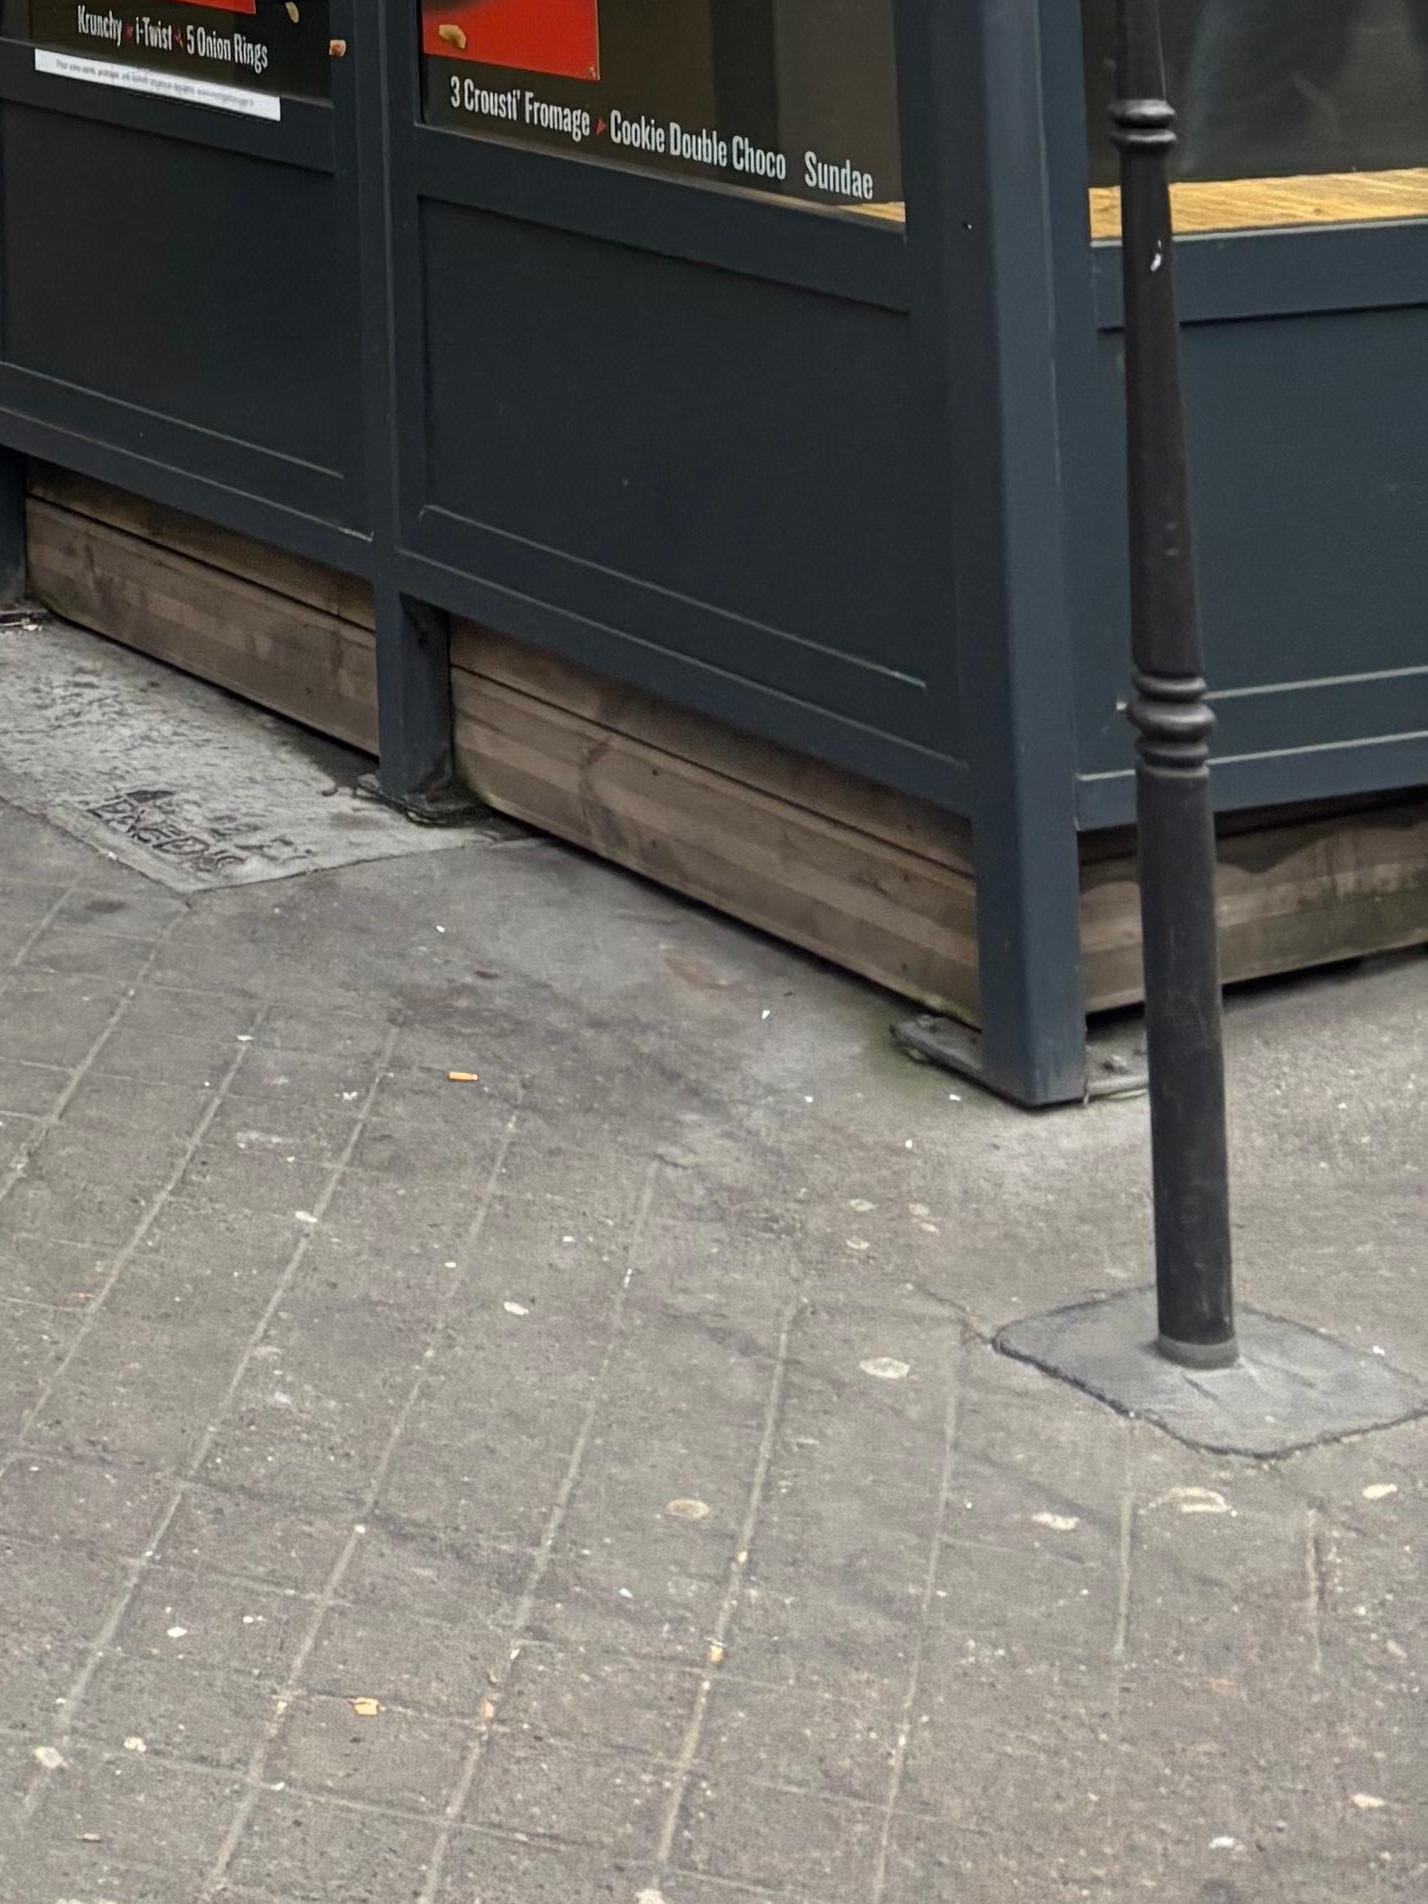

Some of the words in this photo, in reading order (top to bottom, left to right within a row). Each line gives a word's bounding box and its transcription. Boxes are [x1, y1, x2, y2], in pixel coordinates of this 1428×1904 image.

[77, 4, 123, 48] Krunchy
[186, 24, 195, 55] 5
[196, 26, 232, 62] Onion
[233, 32, 269, 74] Rings
[449, 76, 462, 108] 3
[463, 77, 522, 121] Crousti'
[525, 90, 591, 143] Fromage
[609, 109, 666, 154] Cookie
[669, 121, 728, 168] Double
[732, 135, 787, 181] Choco
[804, 151, 874, 200] Sundae
